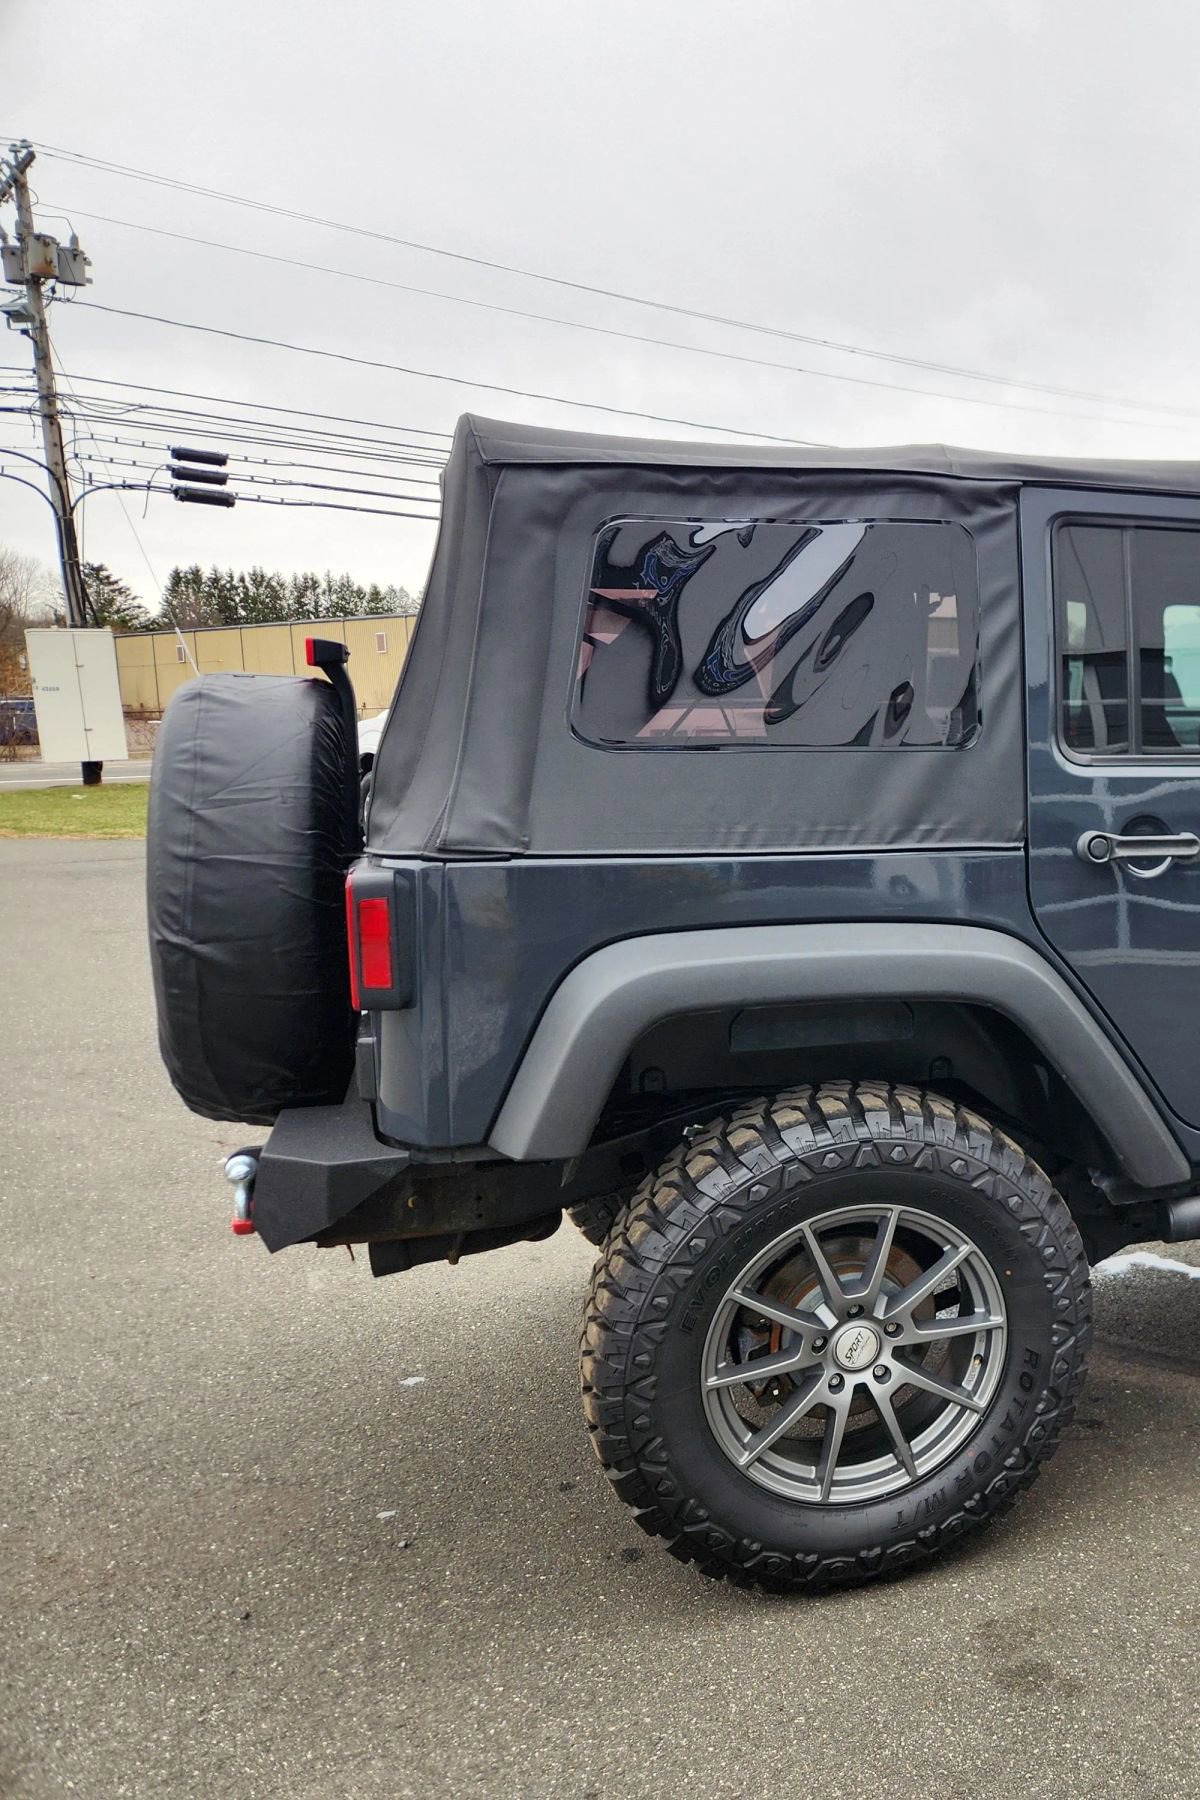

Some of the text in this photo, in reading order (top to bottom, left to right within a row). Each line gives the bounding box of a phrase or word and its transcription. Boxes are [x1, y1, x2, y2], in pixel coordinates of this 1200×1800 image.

[844, 1330, 864, 1362] SPORT
[954, 1347, 1042, 1494] ROTATOR
[889, 1487, 948, 1533] M/T
